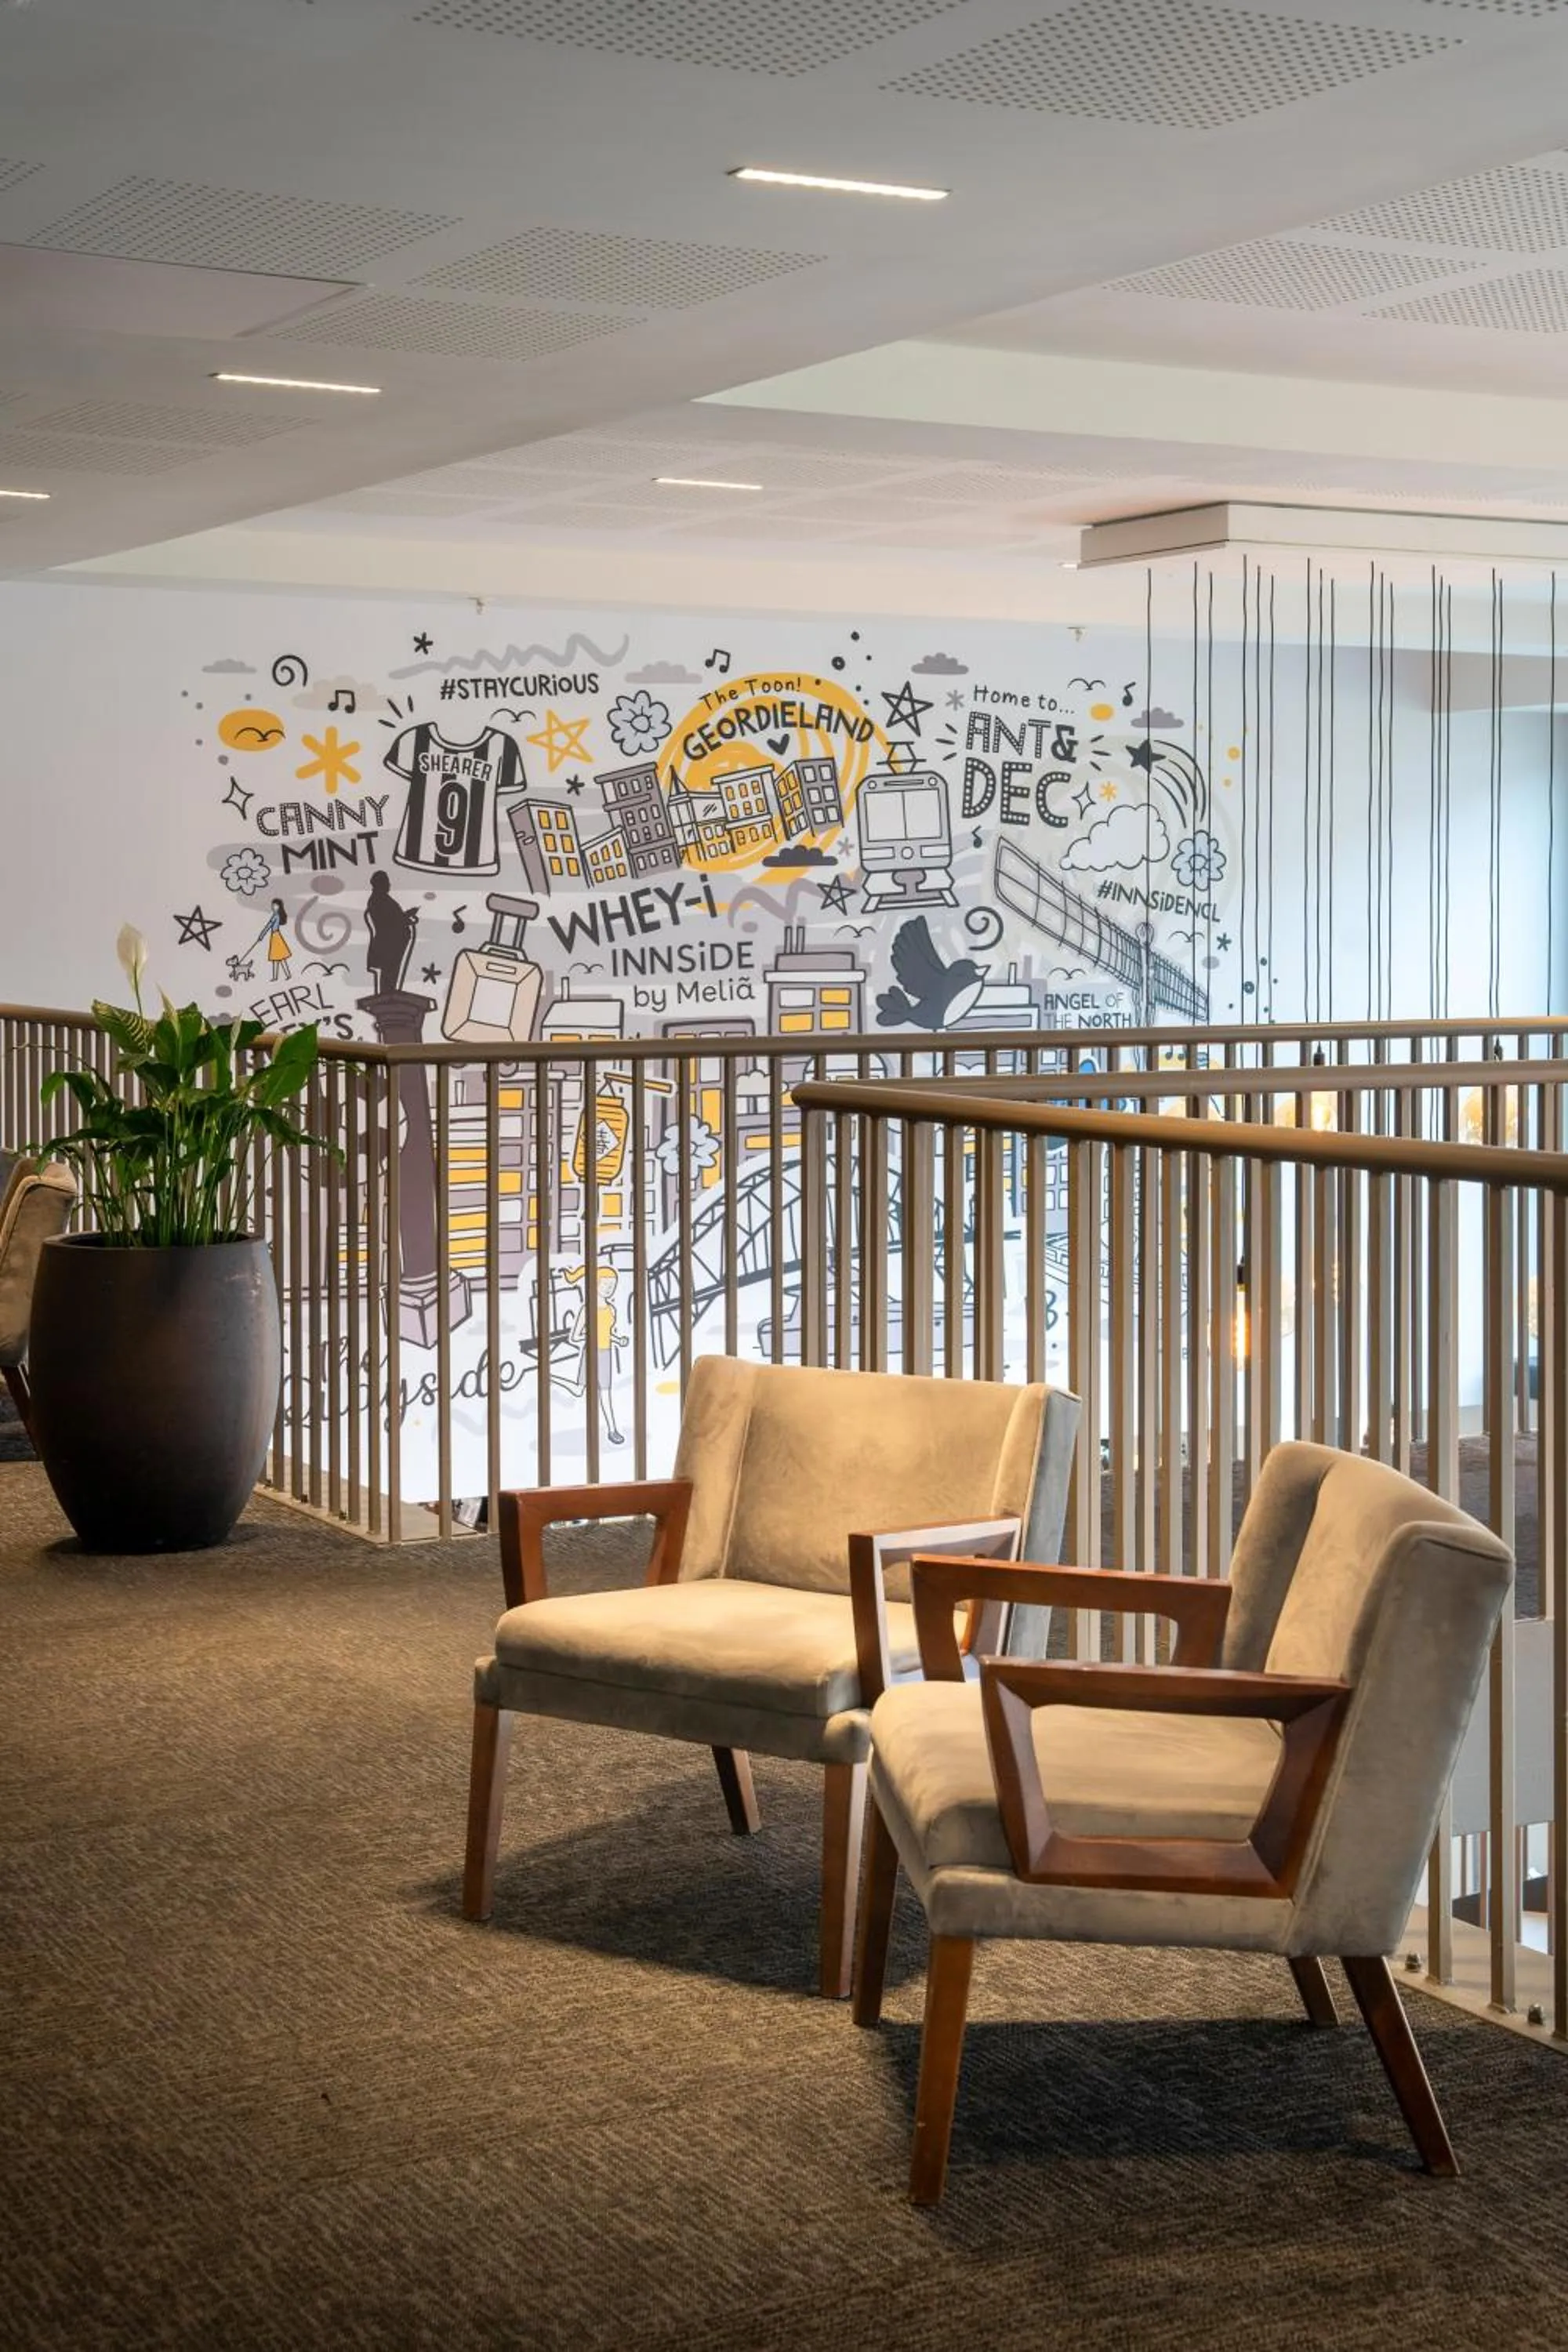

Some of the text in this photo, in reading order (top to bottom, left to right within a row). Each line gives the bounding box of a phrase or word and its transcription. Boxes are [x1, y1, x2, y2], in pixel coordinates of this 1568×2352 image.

[699, 677, 801, 711] The Toon!
[974, 684, 1031, 708] Home
[682, 700, 875, 761] GEORDIELAND
[419, 753, 493, 782] SHEARER
[961, 757, 1072, 829] DEC
[256, 793, 390, 837] CANNY
[434, 781, 469, 856] 9
[281, 830, 379, 875] MINT
[249, 982, 335, 1028] EARL
[633, 985, 666, 1013] by
[1044, 992, 1124, 1011] ANGEL OF
[1043, 1012, 1131, 1029] THE NORTH
